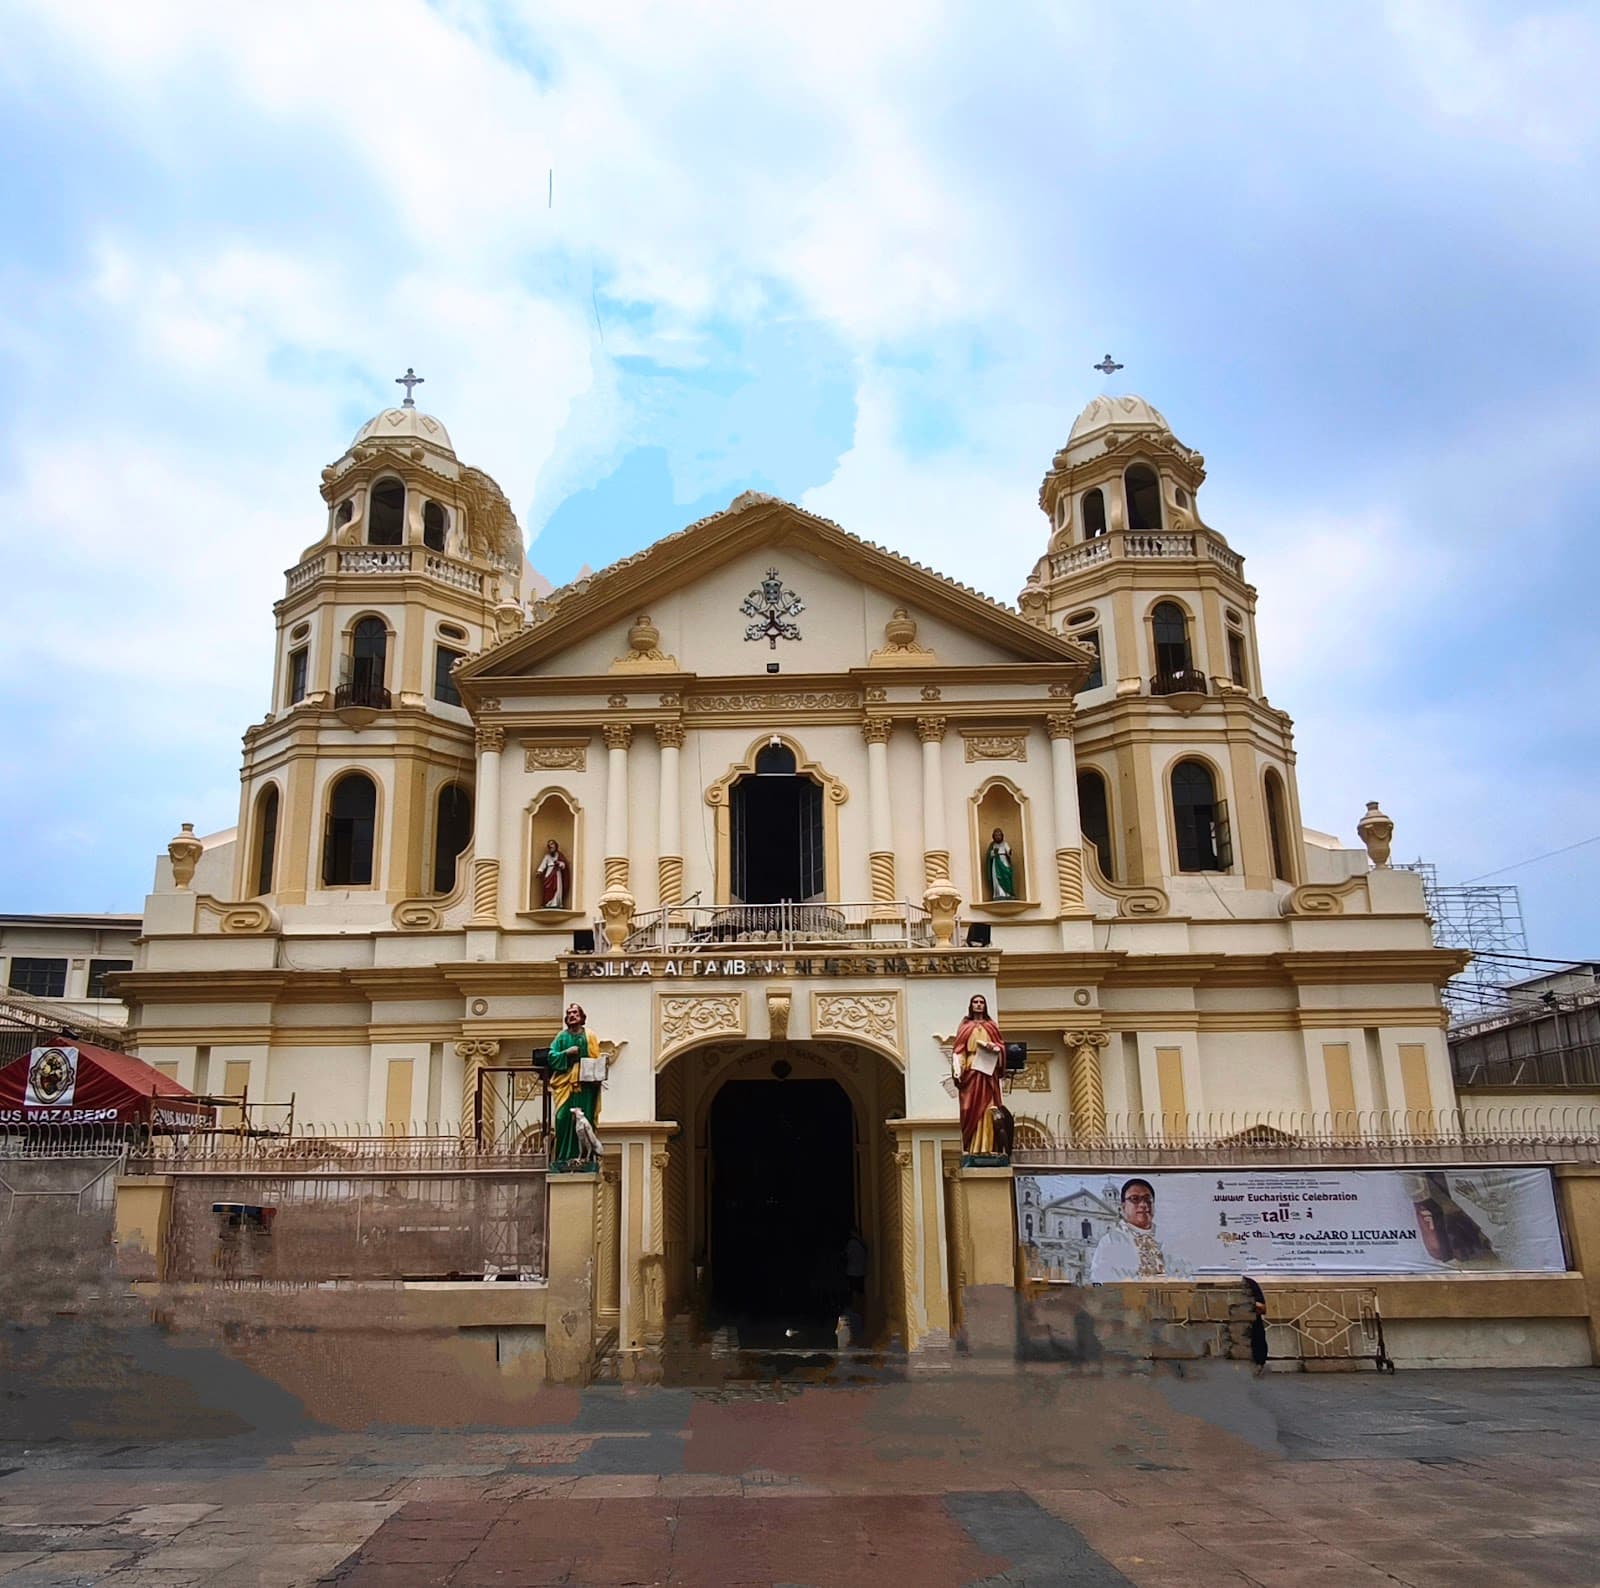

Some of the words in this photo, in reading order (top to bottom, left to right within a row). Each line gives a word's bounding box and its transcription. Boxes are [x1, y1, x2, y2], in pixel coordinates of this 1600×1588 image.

[28, 1108, 118, 1121] NAZARENO
[1247, 1192, 1300, 1202] Eucharistic
[1302, 1191, 1358, 1201] Celebration
[1352, 1229, 1416, 1240] LICUANAN
